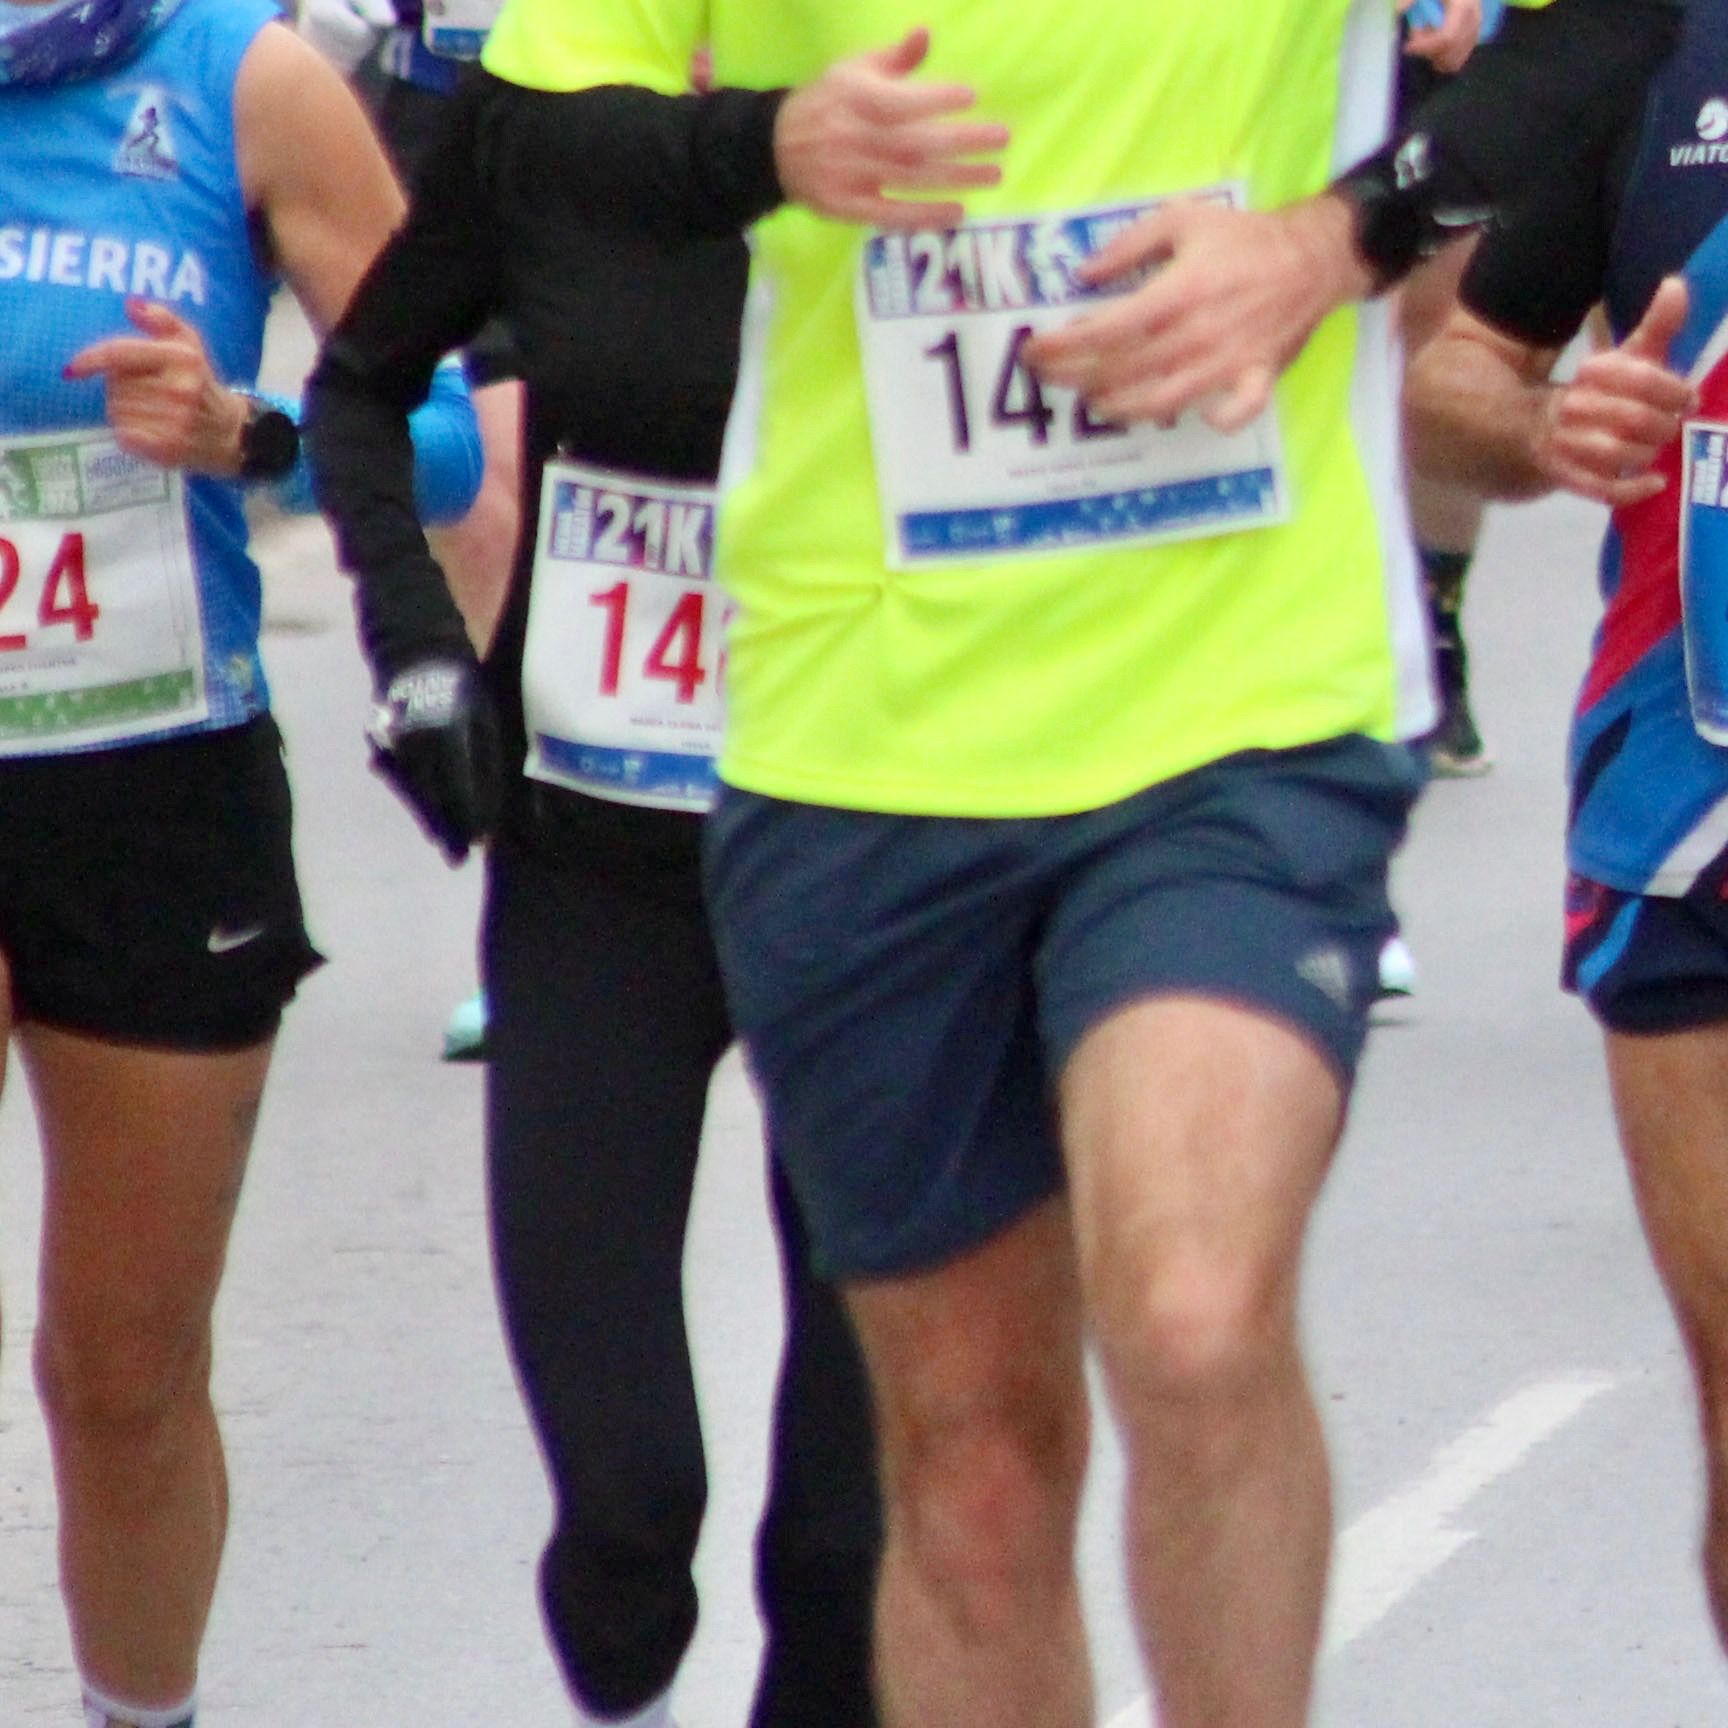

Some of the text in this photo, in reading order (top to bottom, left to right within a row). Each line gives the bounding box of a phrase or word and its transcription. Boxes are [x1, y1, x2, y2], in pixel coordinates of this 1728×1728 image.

[0, 226, 208, 306] SIERRA
[912, 226, 1028, 313] 21K
[592, 488, 706, 575] 21K
[589, 580, 734, 705] 14
